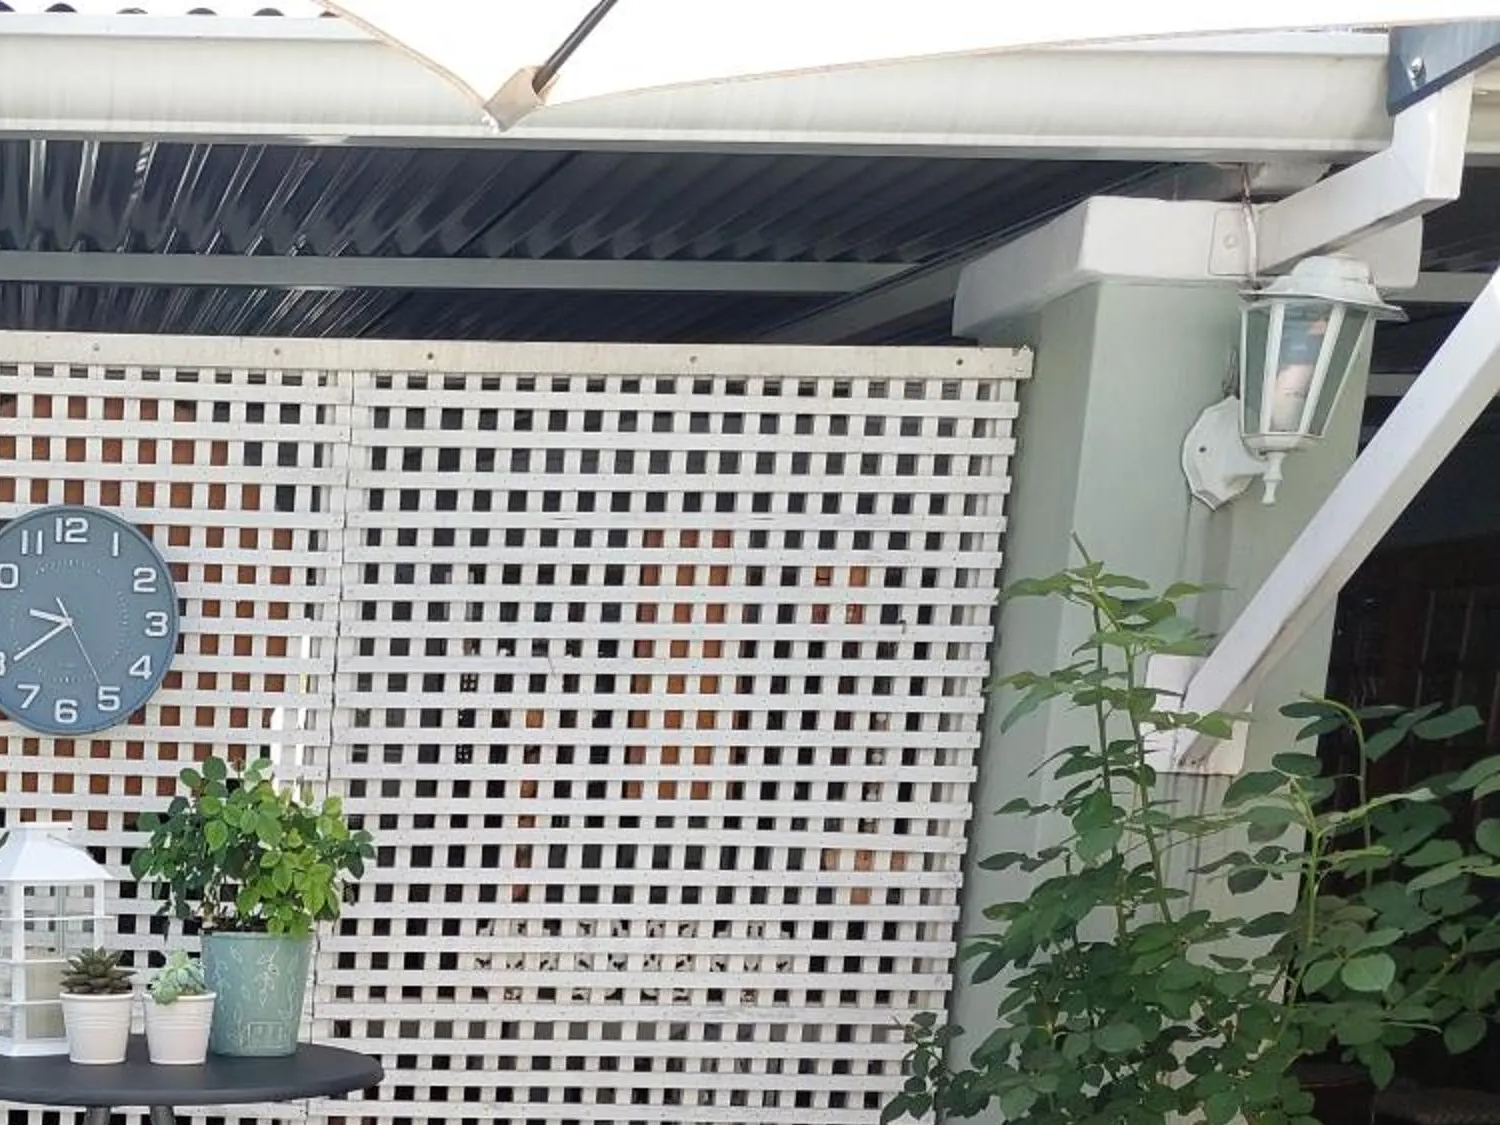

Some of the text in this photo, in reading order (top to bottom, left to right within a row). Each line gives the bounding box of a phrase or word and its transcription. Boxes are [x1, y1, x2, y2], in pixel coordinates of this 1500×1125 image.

[20, 530, 43, 555] 11
[55, 517, 89, 543] 12
[112, 531, 120, 557] 1
[133, 567, 157, 593] 2
[145, 611, 169, 637] 3
[128, 655, 152, 680] 4
[17, 684, 41, 709] 7
[97, 686, 121, 711] 5
[54, 699, 78, 724] 6
